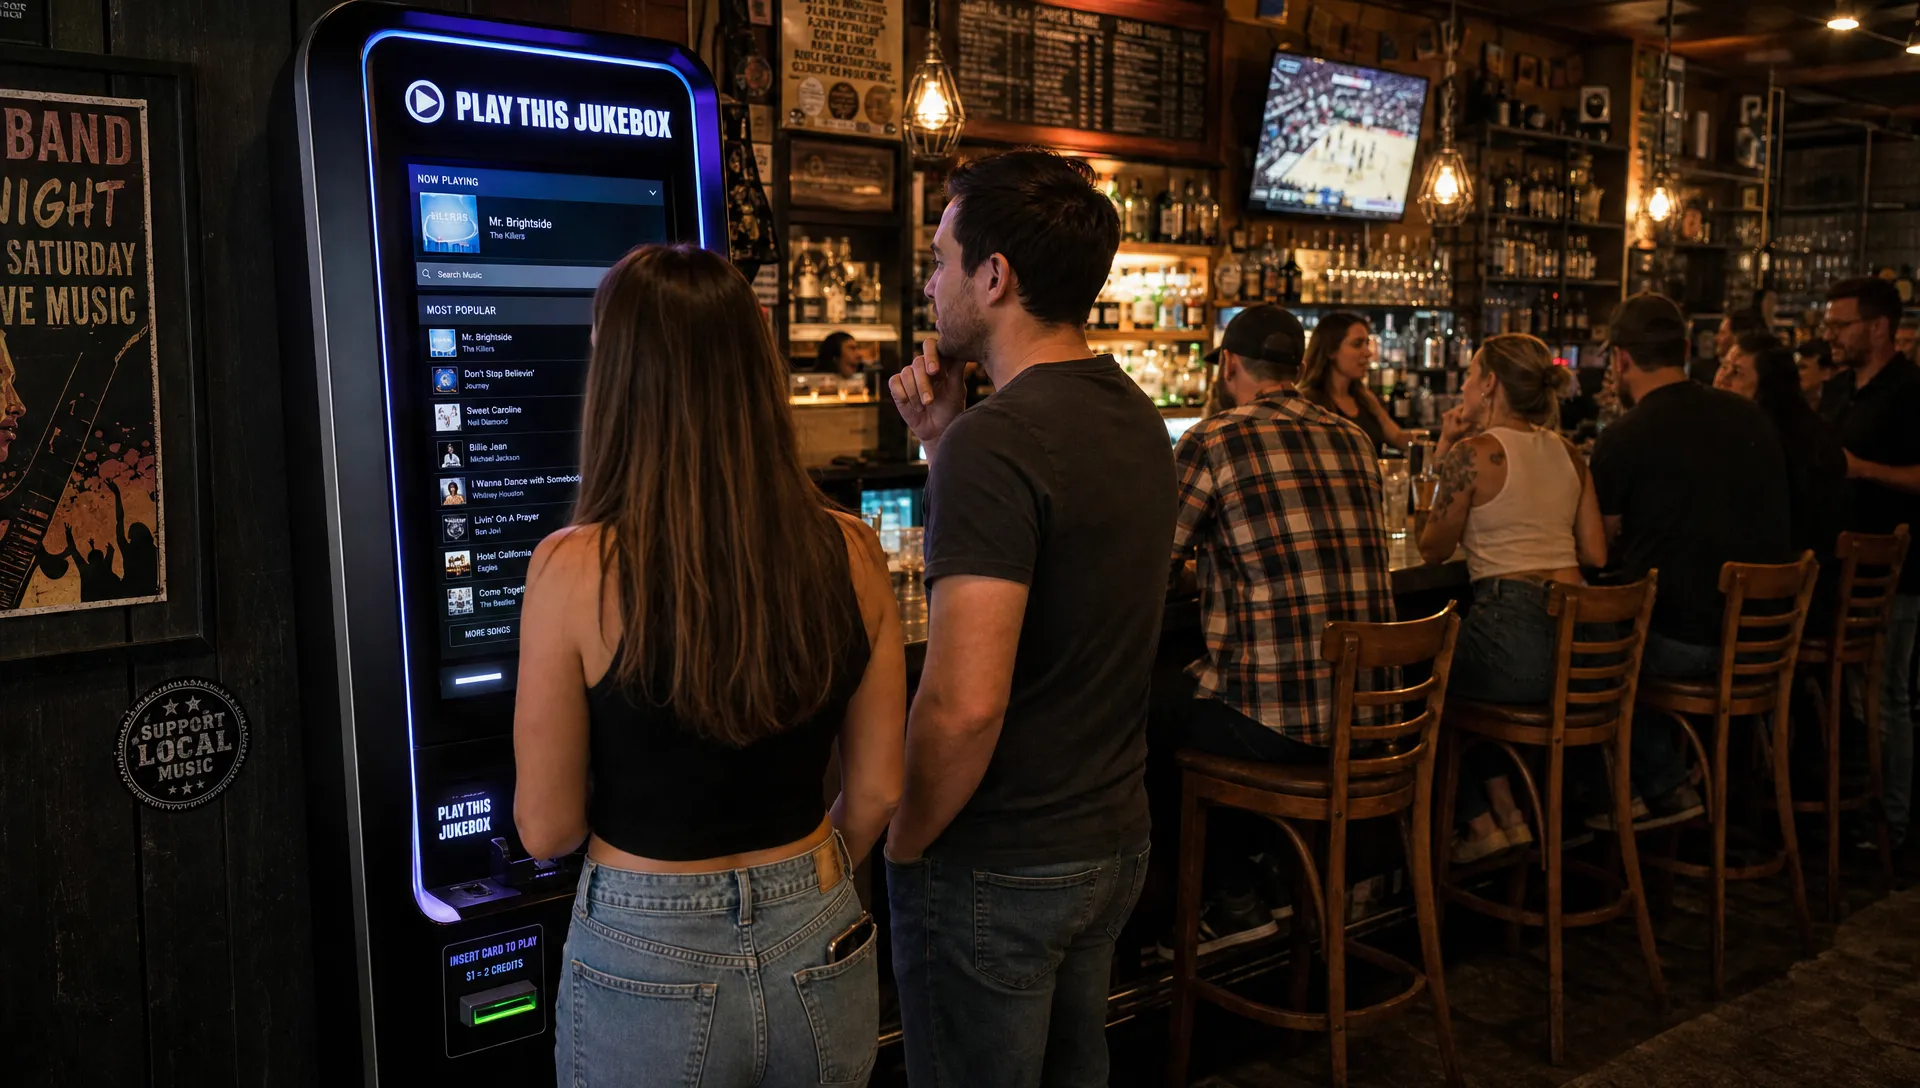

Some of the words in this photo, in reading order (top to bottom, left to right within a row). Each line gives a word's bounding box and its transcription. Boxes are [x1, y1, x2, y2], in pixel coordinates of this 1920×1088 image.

[456, 90, 512, 124] PLAY
[517, 97, 568, 130] THIS
[574, 103, 672, 138] JUKEBOX
[4, 107, 131, 165] BAND
[418, 174, 438, 184] NOW
[442, 176, 478, 186] PLAYING
[489, 216, 504, 226] Mr.
[506, 217, 552, 230] Brightside
[504, 232, 525, 240] Killers
[7, 239, 136, 276] SATURDAY
[438, 270, 460, 278] Search
[46, 286, 136, 326] MUSIC
[426, 306, 452, 314] MOST
[455, 306, 496, 315] POPULAR
[476, 333, 512, 342] Brightside
[486, 370, 502, 379] Stop
[505, 369, 535, 377] Believin'
[492, 406, 522, 414] Caroline
[470, 443, 487, 451] Billie
[504, 478, 527, 486] Dance
[530, 476, 544, 484] with
[474, 516, 493, 524] Livin'
[509, 514, 514, 522] A
[516, 514, 539, 522] Prayer
[477, 552, 496, 560] Hotel
[498, 549, 532, 558] California
[502, 586, 526, 595] Togeth
[465, 629, 485, 638] MORE
[141, 712, 226, 740] SUPPORT
[138, 730, 232, 767] LOCAL
[158, 758, 213, 782] MUSIC
[438, 803, 464, 821] PLAY
[466, 798, 491, 816] THIS
[439, 817, 491, 840] JUKEBOX
[450, 950, 480, 967] INSERT
[482, 944, 504, 958] CARD
[505, 941, 516, 952] TO
[518, 936, 537, 949] PLAY
[466, 970, 475, 981] $1
[484, 967, 489, 976] 2
[491, 958, 523, 975] CREDITS
